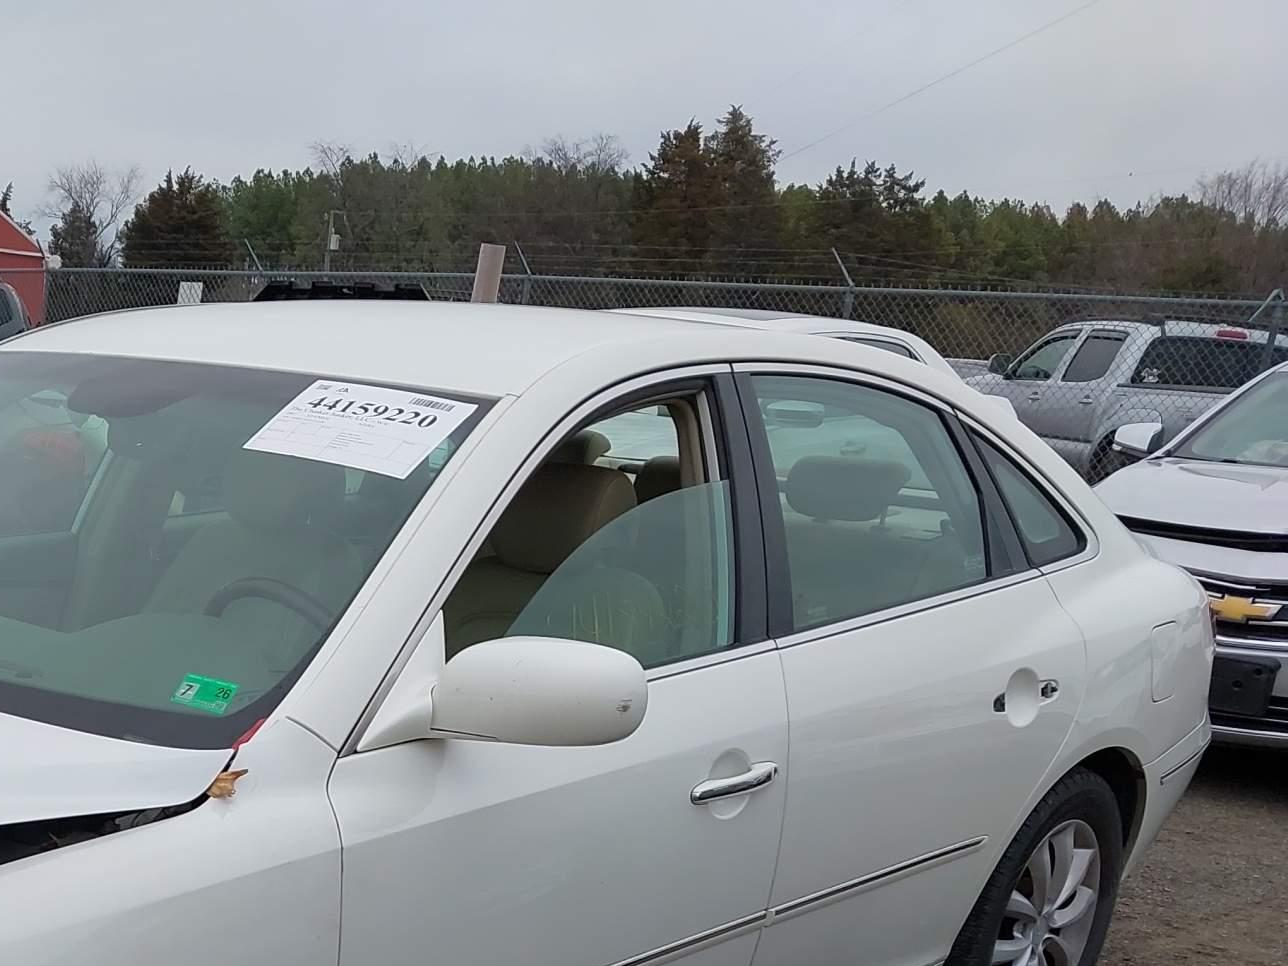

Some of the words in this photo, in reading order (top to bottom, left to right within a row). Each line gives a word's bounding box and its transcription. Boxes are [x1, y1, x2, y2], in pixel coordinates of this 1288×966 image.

[308, 396, 438, 428] 44159220
[180, 684, 194, 696] 7
[215, 687, 232, 699] 26
